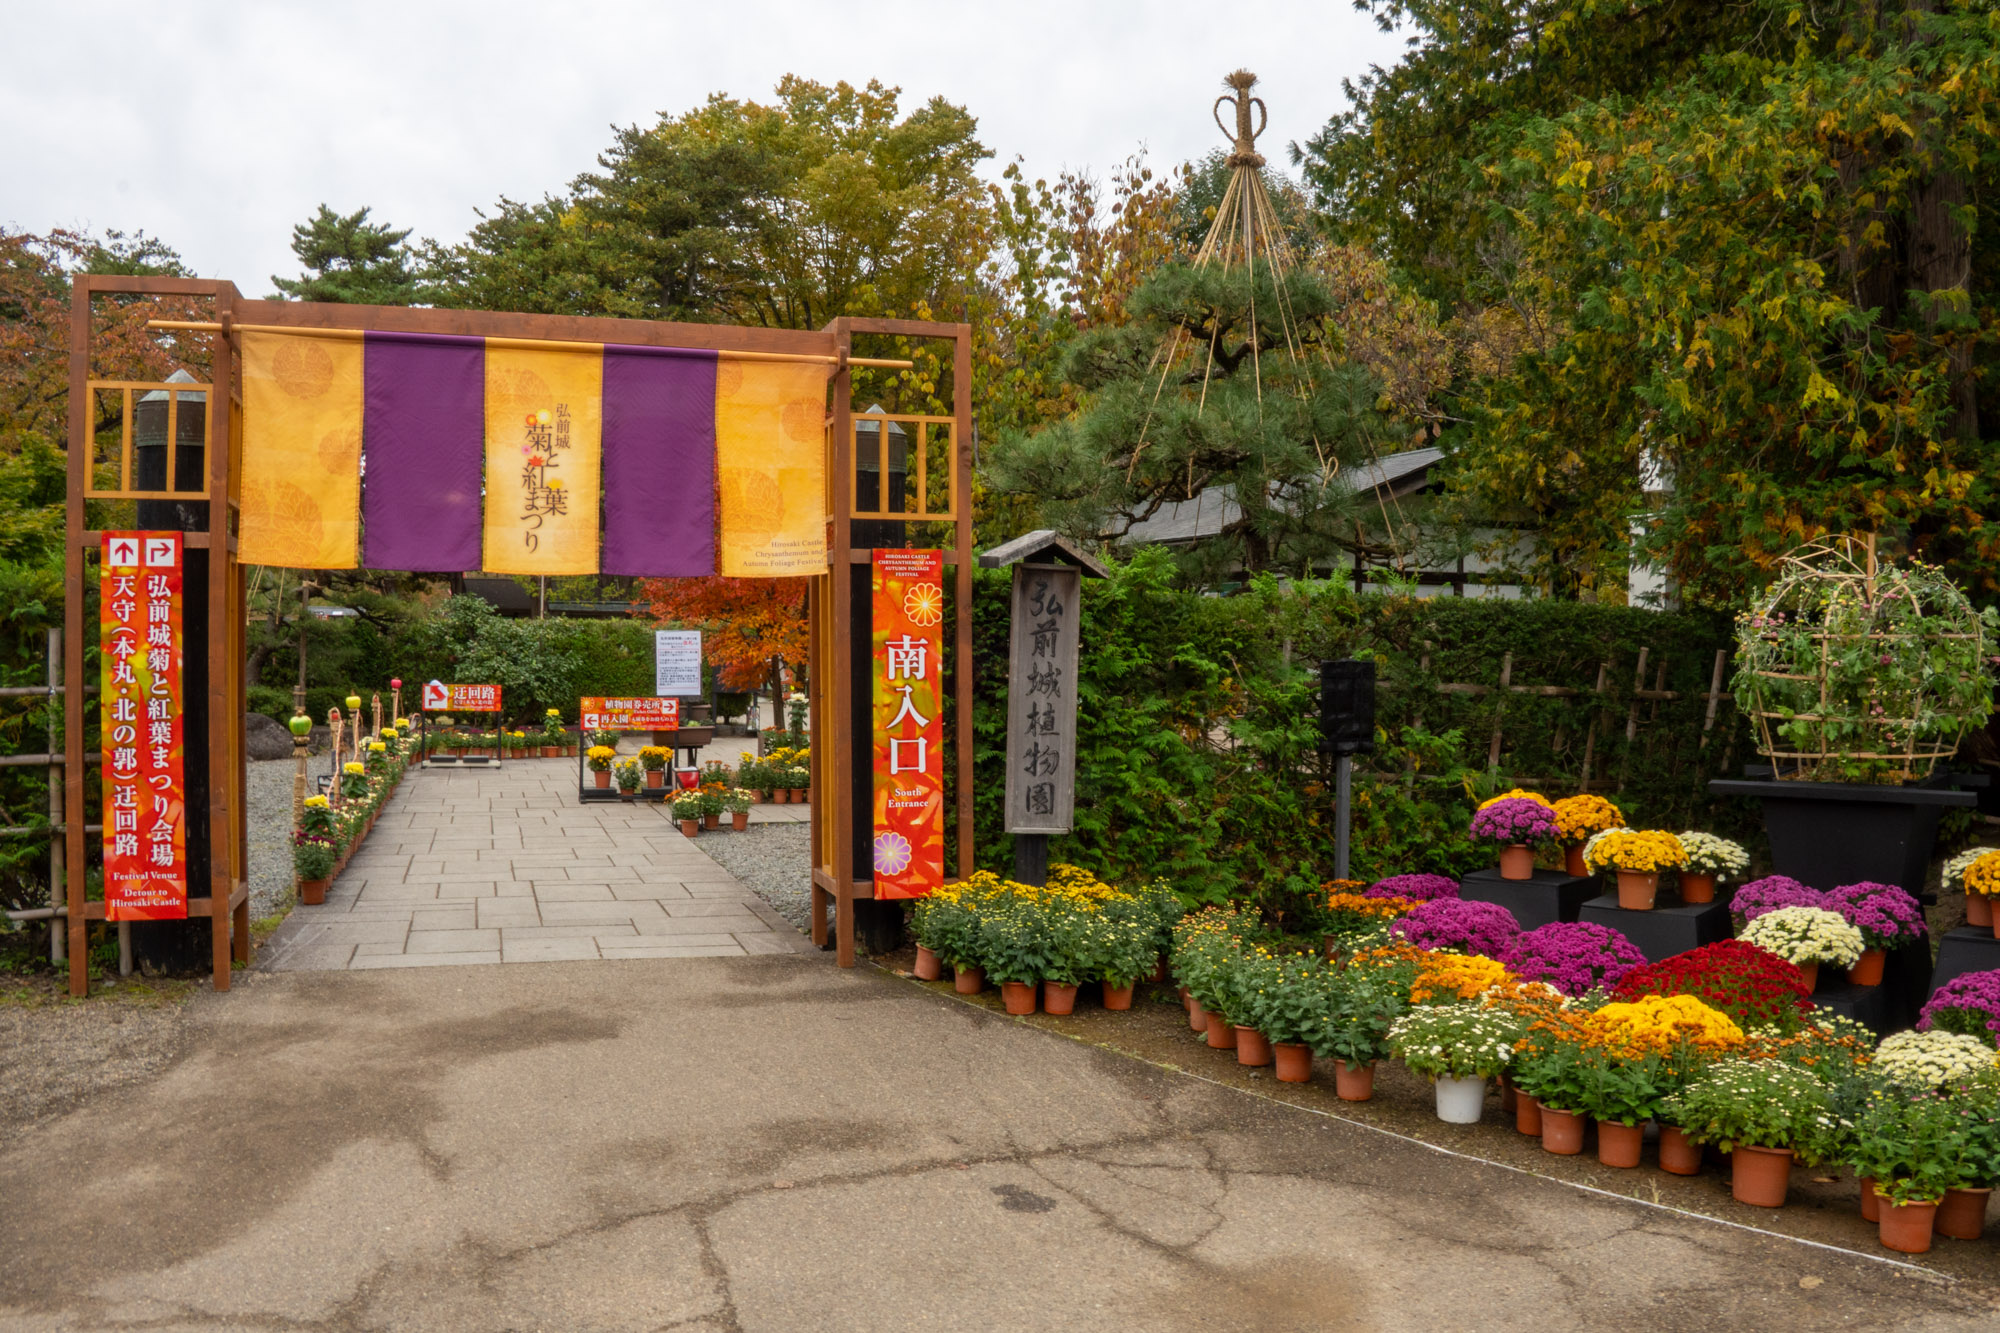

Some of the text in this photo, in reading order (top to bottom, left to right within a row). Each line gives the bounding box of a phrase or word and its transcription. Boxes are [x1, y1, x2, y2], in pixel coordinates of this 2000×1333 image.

[555, 403, 571, 449] 弘前城
[453, 687, 495, 700] 迂回路
[1023, 580, 1064, 816] 弘前城植物園
[605, 700, 660, 709] 植物園券売所
[885, 634, 930, 775] 南入口
[147, 575, 175, 867] 弘前城菊と紅葉まつり会場
[601, 714, 628, 723] 再入園
[895, 788, 922, 797] South
[888, 800, 929, 808] Entrance
[113, 871, 178, 880] Festival Venue
[124, 889, 157, 897] Detour
[112, 897, 181, 908] Hirosaki Castle
